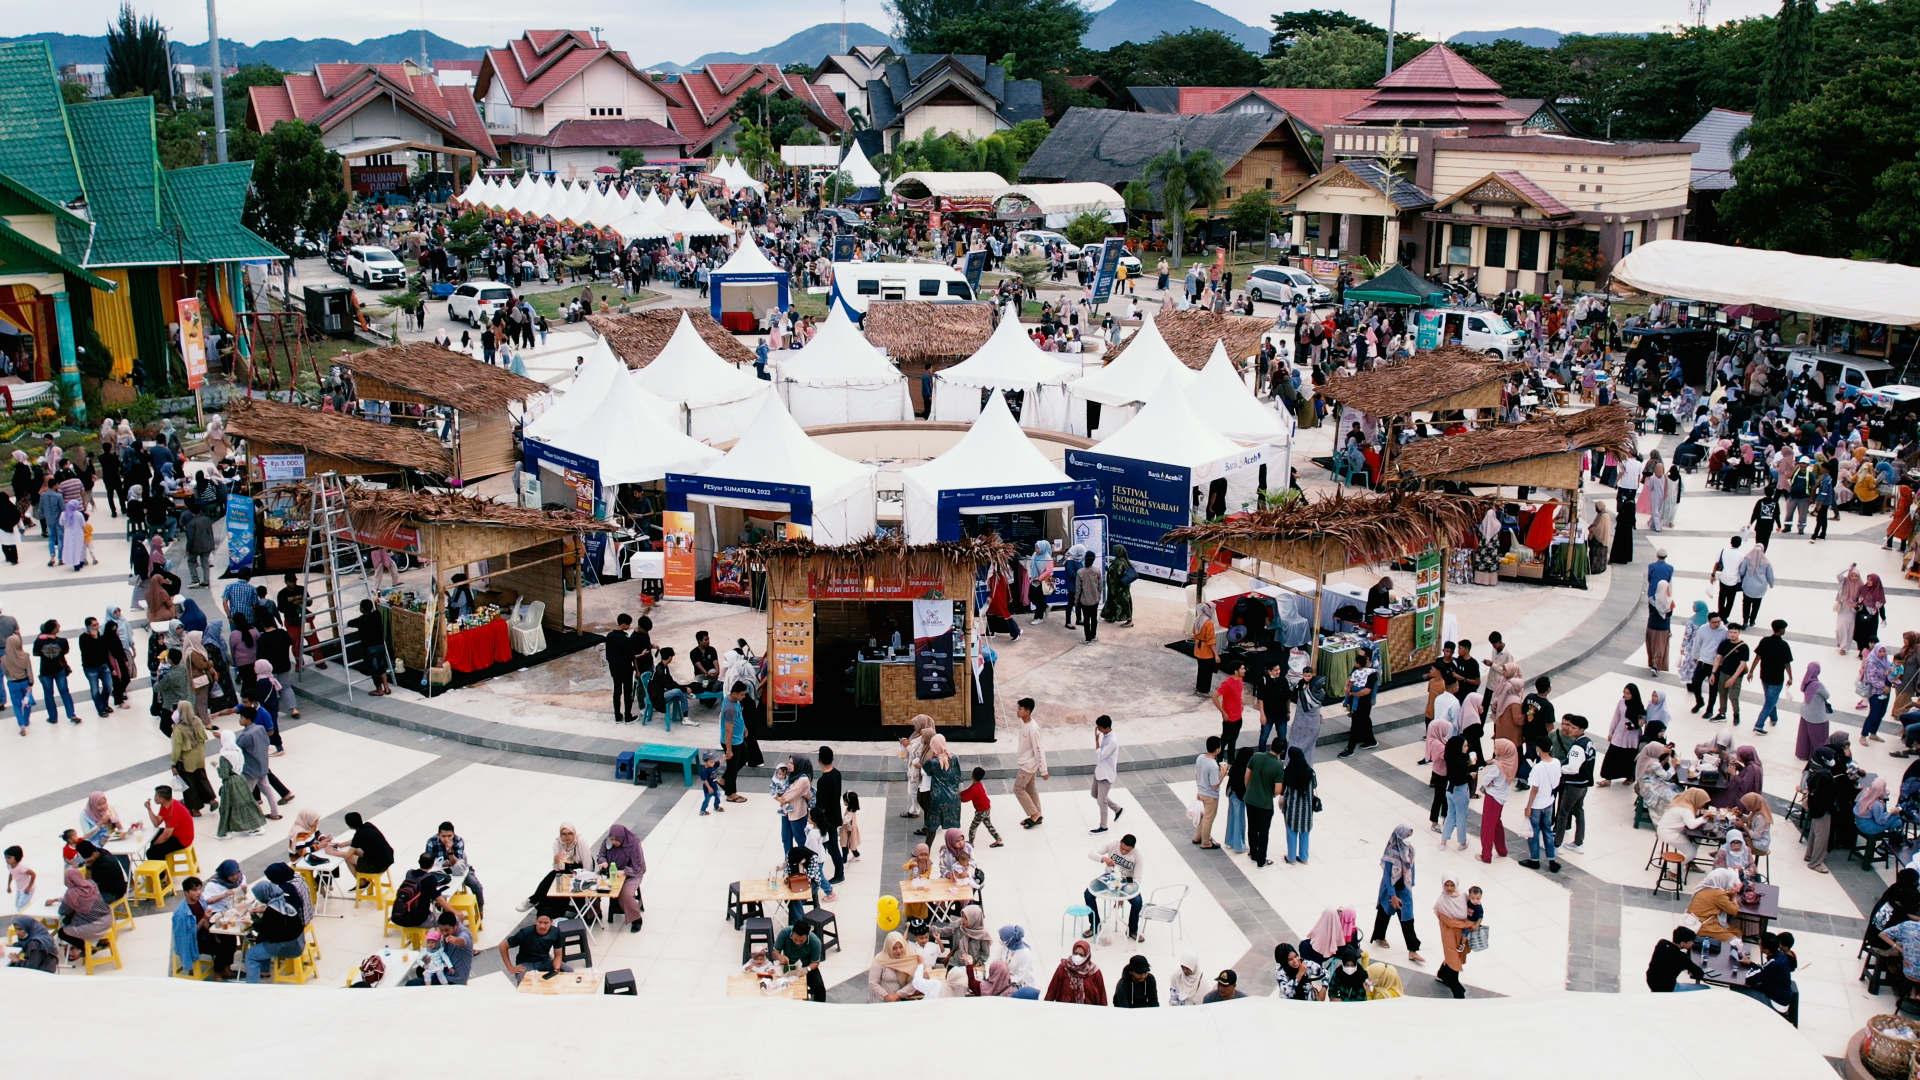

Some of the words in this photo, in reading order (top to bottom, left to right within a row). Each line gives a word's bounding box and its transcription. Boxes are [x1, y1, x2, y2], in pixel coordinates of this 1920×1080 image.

[361, 172, 403, 182] CULINARY
[1243, 453, 1258, 465] Aceh
[1148, 470, 1160, 478] Bank
[703, 484, 723, 492] FESyar
[723, 485, 757, 494] SUMATERA
[757, 488, 771, 496] 2022
[1112, 485, 1150, 500] FESTIVAL
[981, 494, 1003, 502] FESyar
[1004, 491, 1039, 500] SUMATERA
[1111, 502, 1150, 516] SUMATERA
[1112, 494, 1147, 508] EKONOMI
[1147, 500, 1180, 513] SYARIAH
[1136, 518, 1160, 528] AGUSTUS
[1160, 522, 1173, 530] 2022
